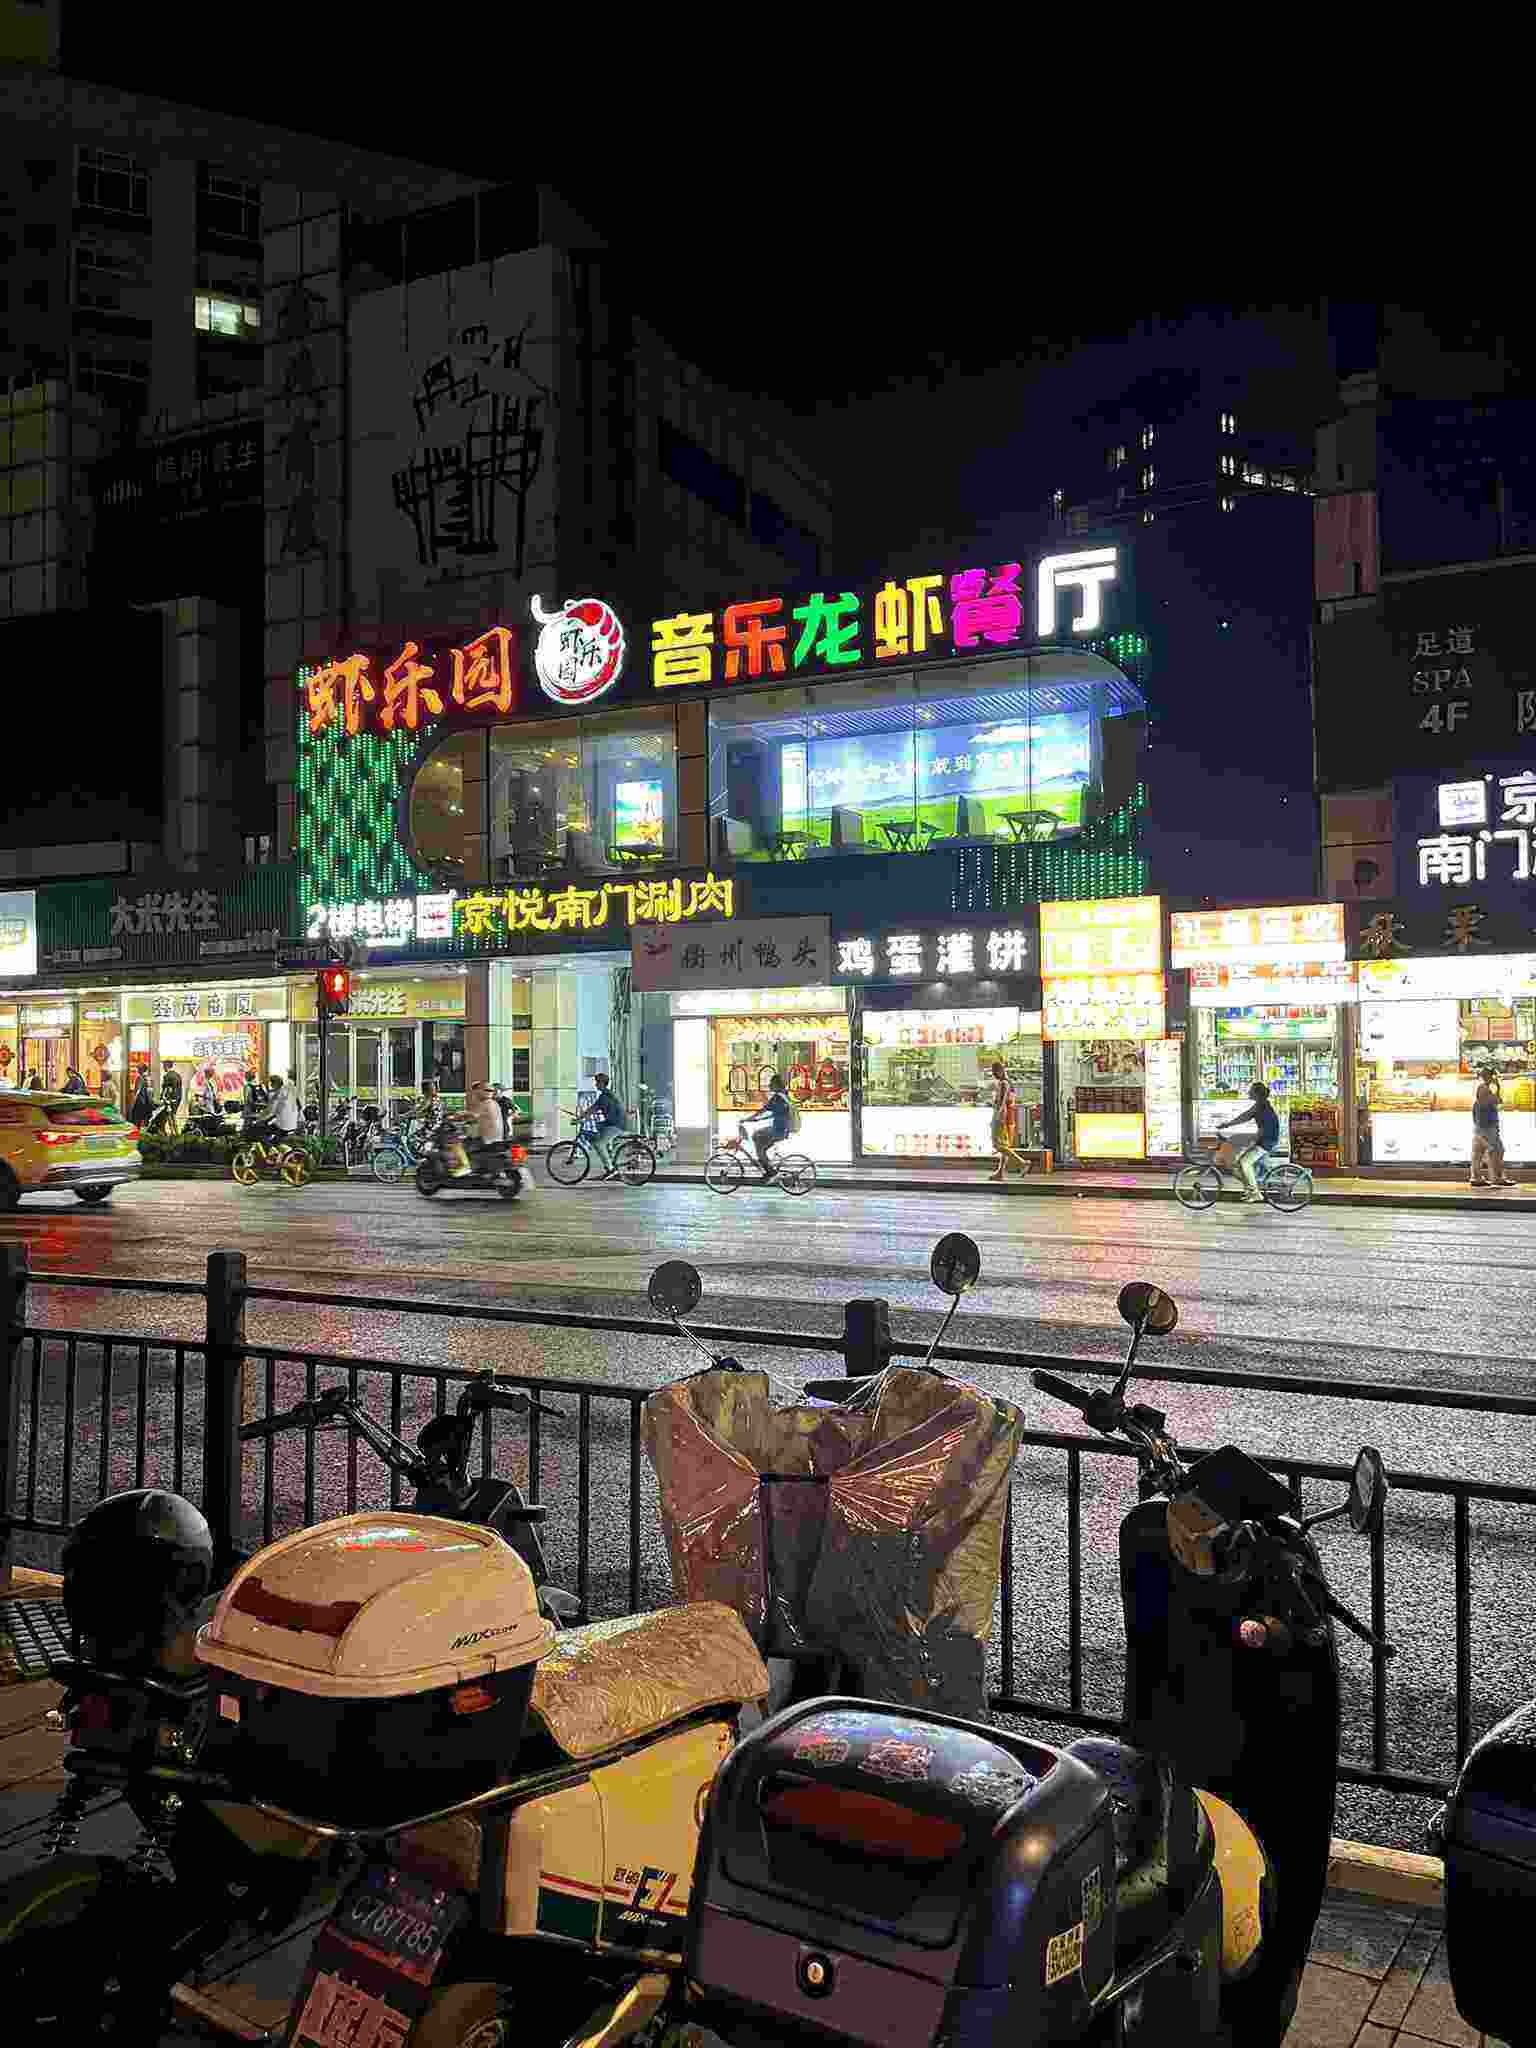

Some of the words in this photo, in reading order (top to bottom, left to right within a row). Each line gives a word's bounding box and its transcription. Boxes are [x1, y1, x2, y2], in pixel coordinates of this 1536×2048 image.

[650, 546, 1119, 687] 音乐龙虾餐厅
[1413, 626, 1475, 660] 足道
[305, 626, 513, 735] 虾乐园
[1413, 664, 1473, 695] SPA
[1418, 701, 1470, 735] 4F
[456, 873, 734, 933] 京悦南门涮肉
[837, 930, 1028, 977] 鸡蛋灌饼
